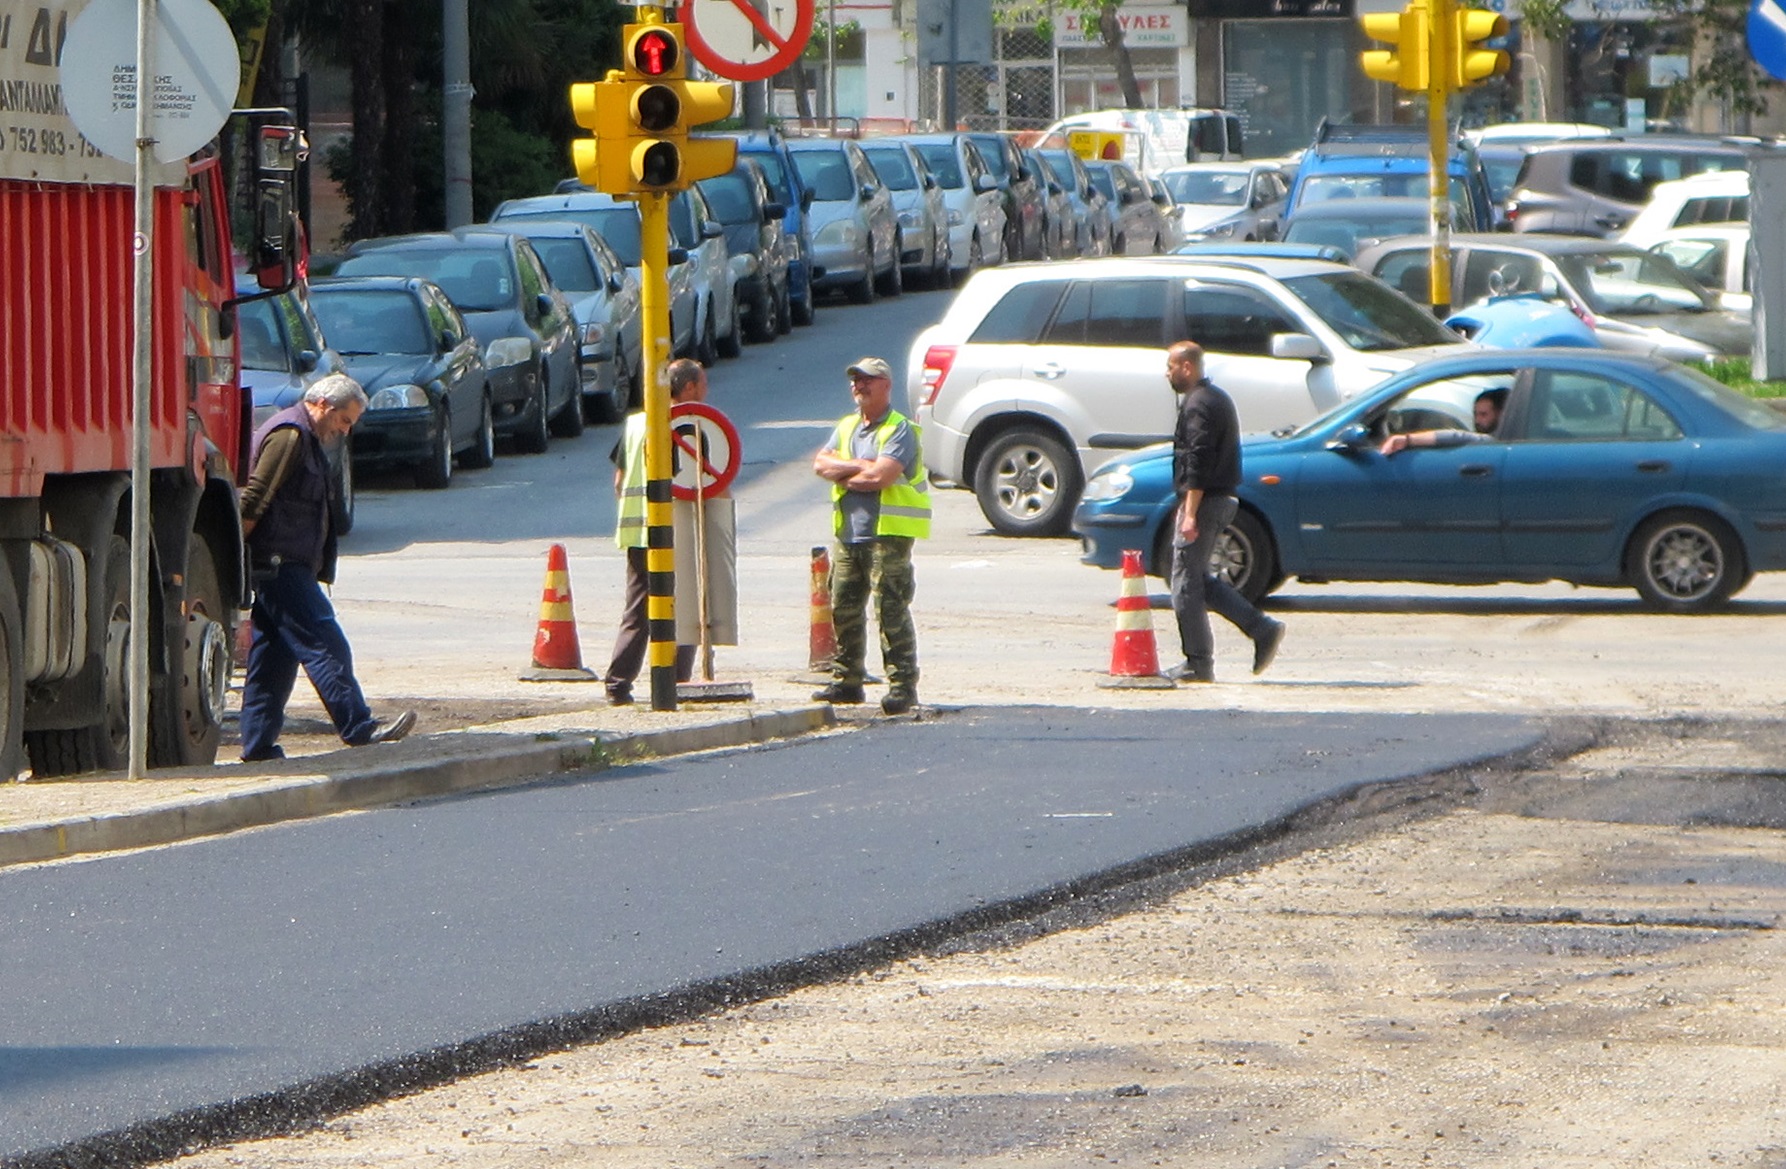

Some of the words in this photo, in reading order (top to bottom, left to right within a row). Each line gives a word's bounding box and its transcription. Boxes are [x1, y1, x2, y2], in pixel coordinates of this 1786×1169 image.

[1066, 14, 1171, 30] ΣΥΛΕΣ
[9, 126, 39, 154] 752
[41, 128, 66, 156] 983
